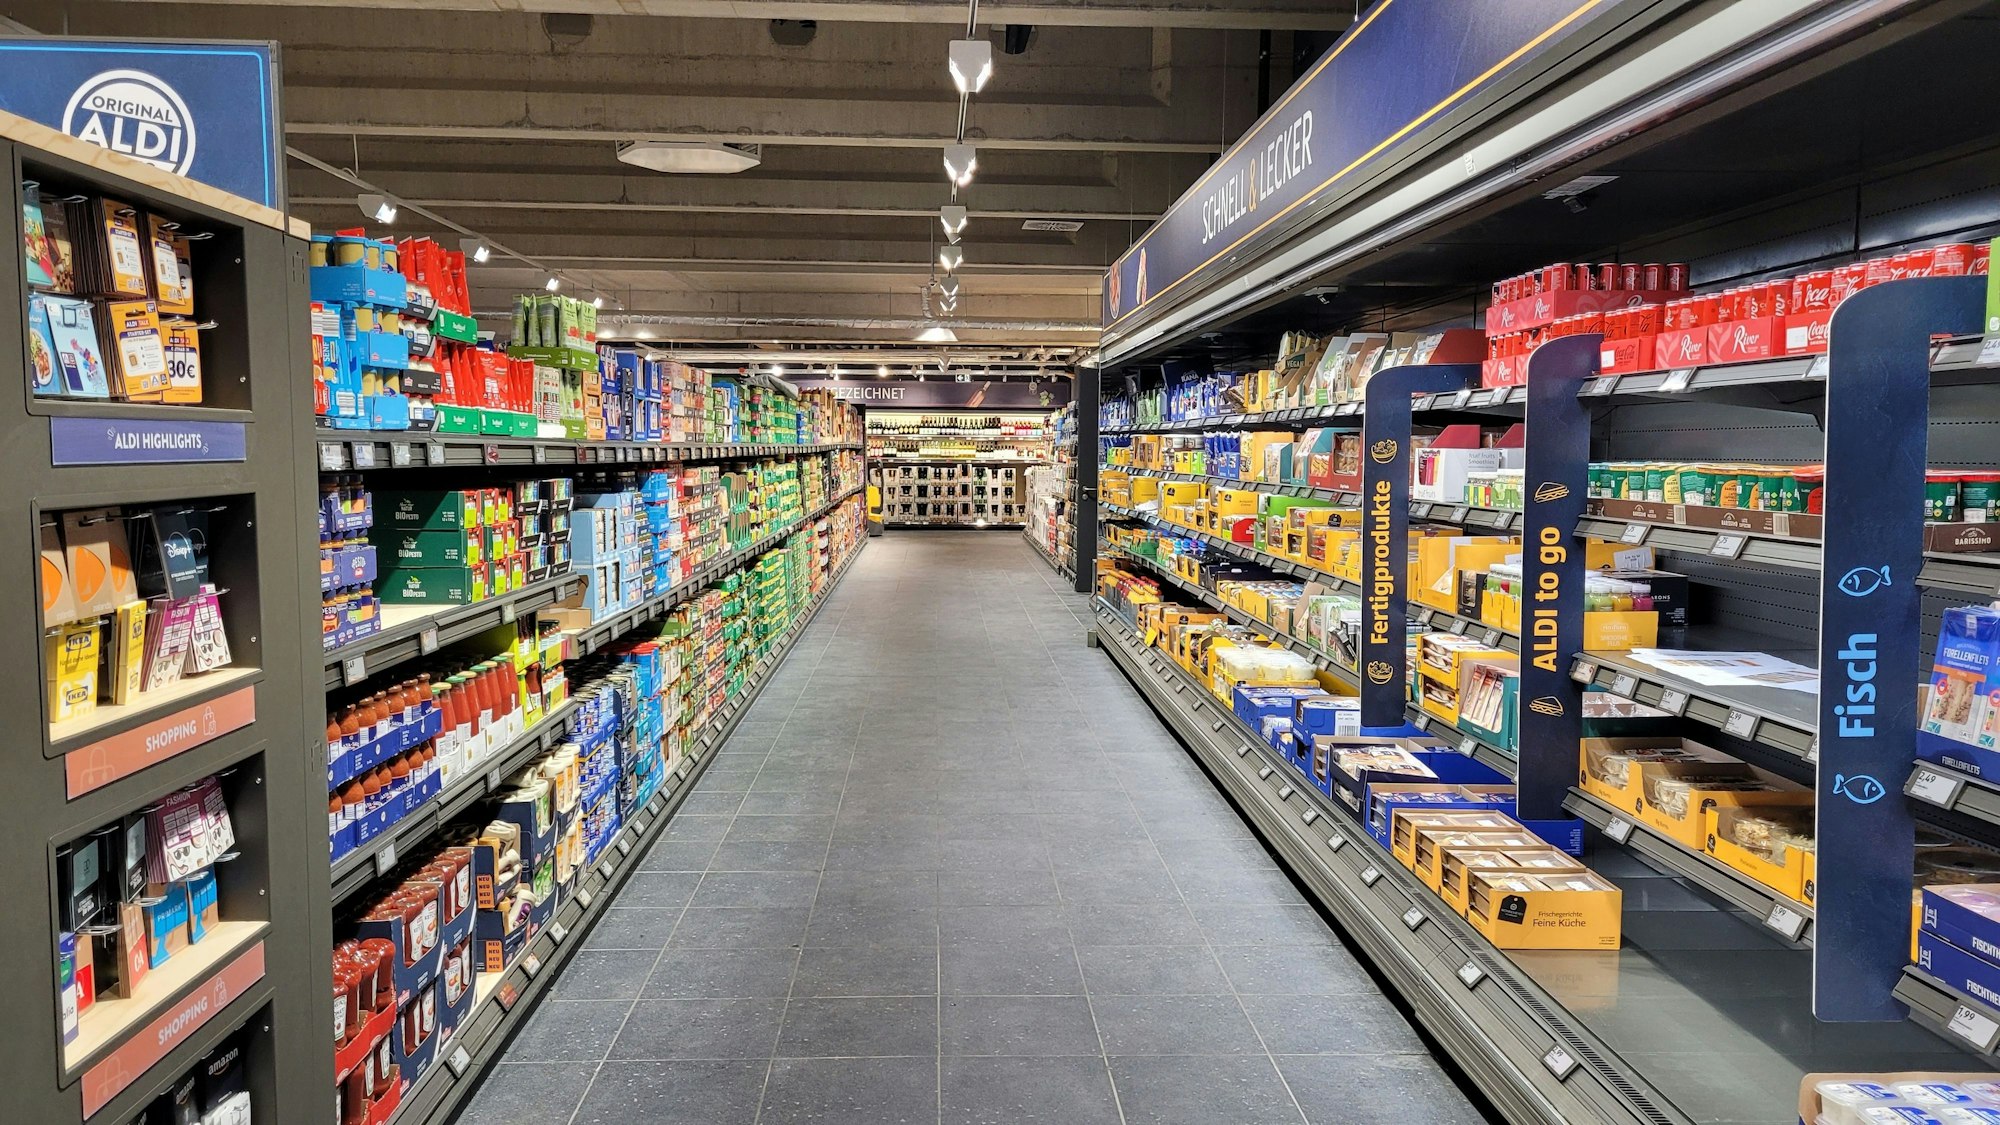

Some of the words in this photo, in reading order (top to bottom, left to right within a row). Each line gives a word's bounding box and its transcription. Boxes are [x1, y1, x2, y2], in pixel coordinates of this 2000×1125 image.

[92, 95, 173, 122] ORIGINAL
[78, 112, 182, 162] ALDI
[1202, 169, 1247, 244] SCHNELL
[1248, 158, 1257, 212] &
[1259, 110, 1312, 202] LECKER
[1732, 325, 1760, 354] River
[818, 387, 906, 400] GEZEICHNET
[114, 434, 140, 450] ALDI
[142, 434, 202, 450] HIGHLIGHTS
[1540, 527, 1567, 564] go
[1954, 537, 1992, 546] BARISSIMO
[1370, 480, 1394, 644] Fertigprodukte
[1538, 572, 1560, 602] to
[1533, 610, 1558, 672] ALDI
[1943, 647, 1989, 666] FORELLENFILETS
[68, 690, 86, 700] IKEA
[1834, 633, 1878, 738] Fisch
[146, 720, 197, 753] SHOPPING
[1918, 772, 1936, 784] 2,49
[1942, 756, 1980, 776] FORELLENFILETS
[1532, 919, 1556, 927] Feine
[1558, 918, 1586, 927] Küche
[158, 998, 208, 1046] SHOPPING
[1958, 1007, 1975, 1021] 1,99
[208, 1048, 238, 1075] amazon
